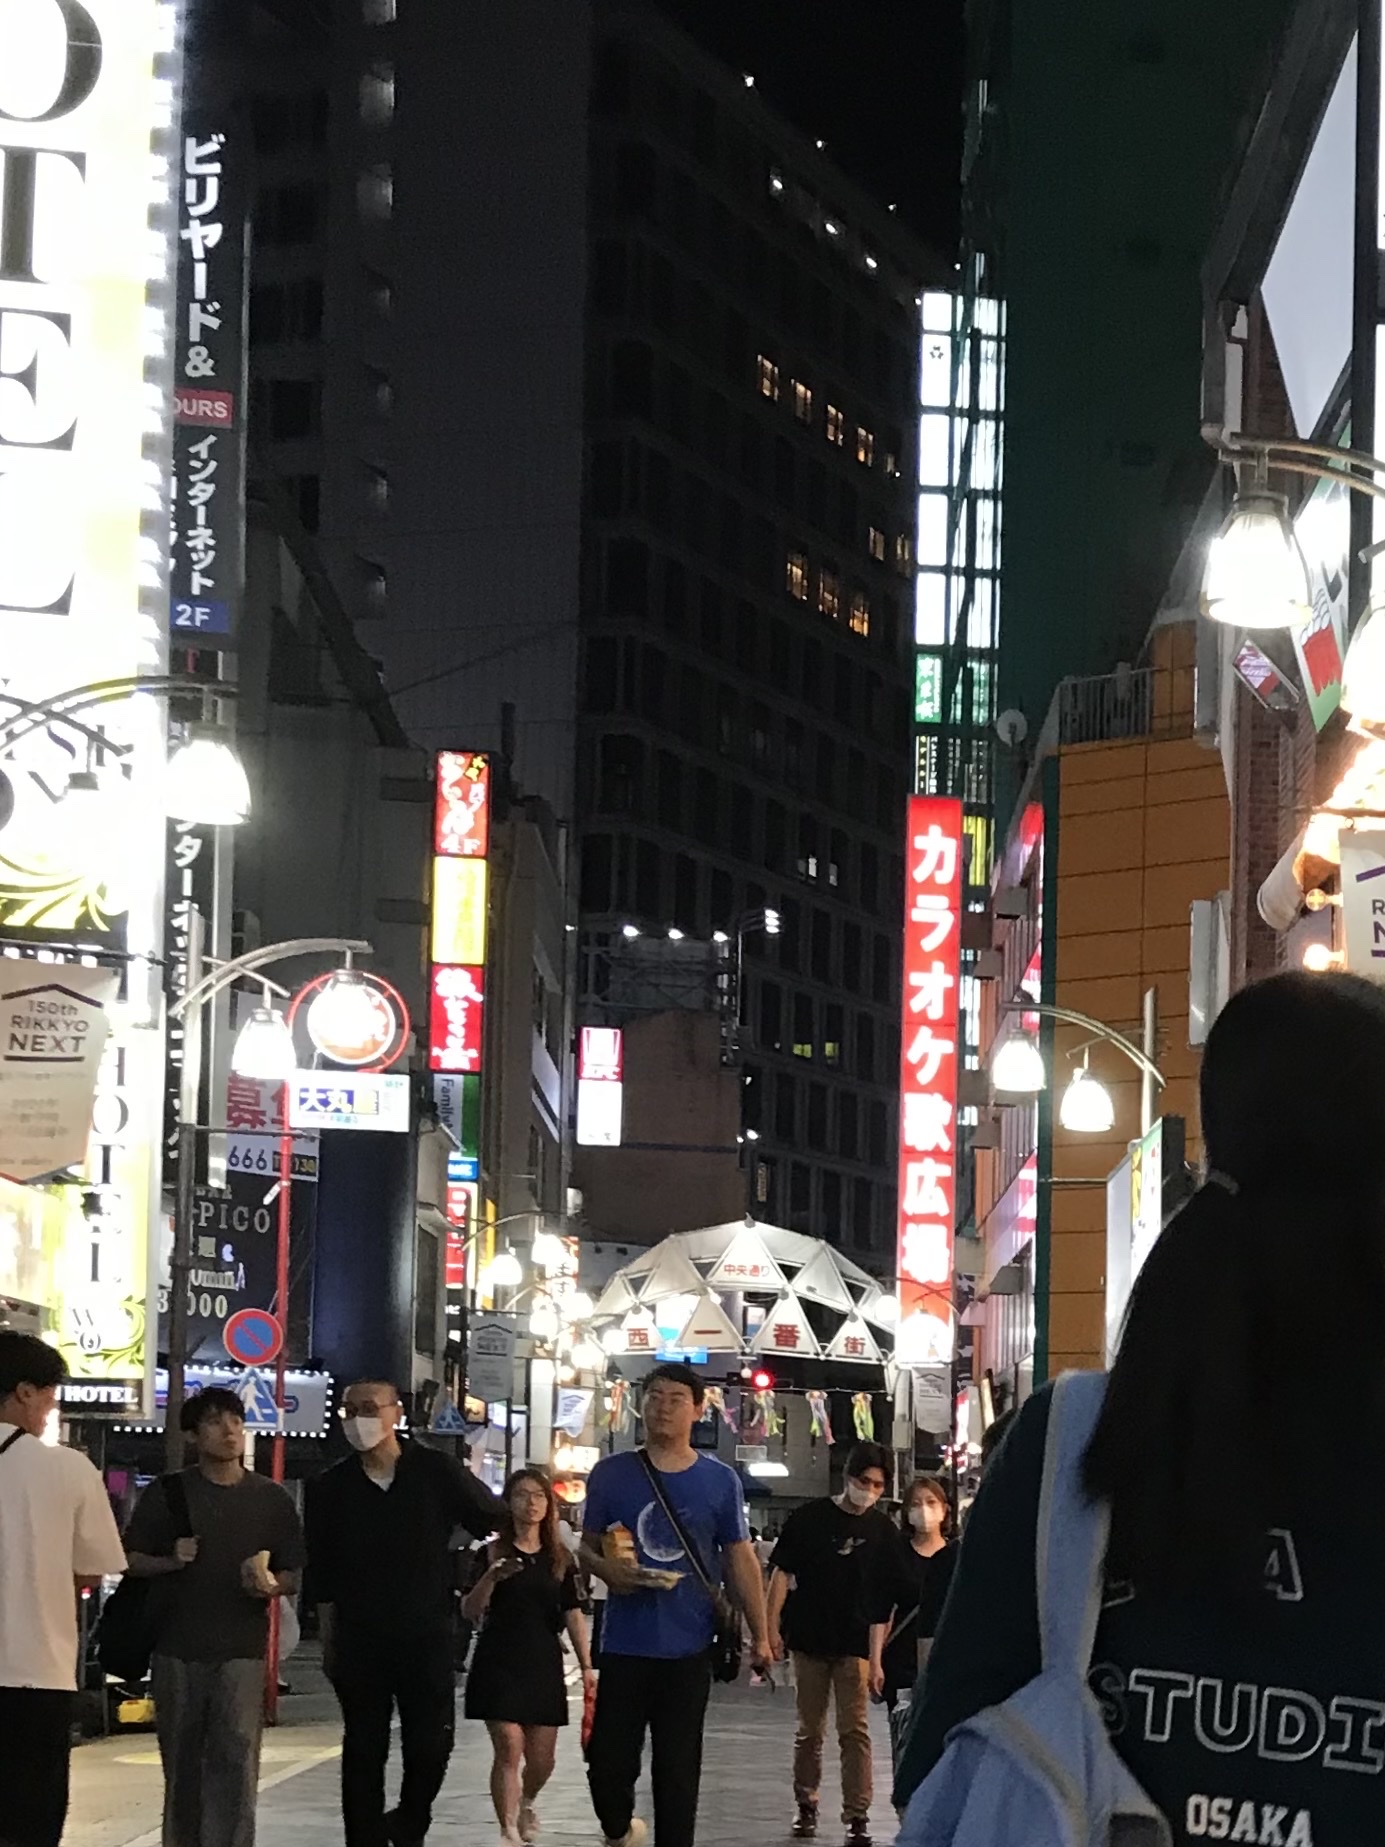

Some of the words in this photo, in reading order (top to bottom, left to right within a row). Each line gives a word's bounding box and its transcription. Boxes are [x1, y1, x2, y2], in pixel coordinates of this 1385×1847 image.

[180, 132, 226, 378] ビリヤード&
[185, 434, 218, 596] インターネット
[175, 604, 211, 628] 2F
[27, 1000, 79, 1016] 150th
[10, 1015, 90, 1032] RIKKYO
[9, 1033, 86, 1053] NEXT
[902, 825, 957, 1285] カラオケ歌広場
[228, 1145, 268, 1171] 666
[723, 1263, 771, 1278] 中央通り
[628, 1322, 867, 1356] 西一番街
